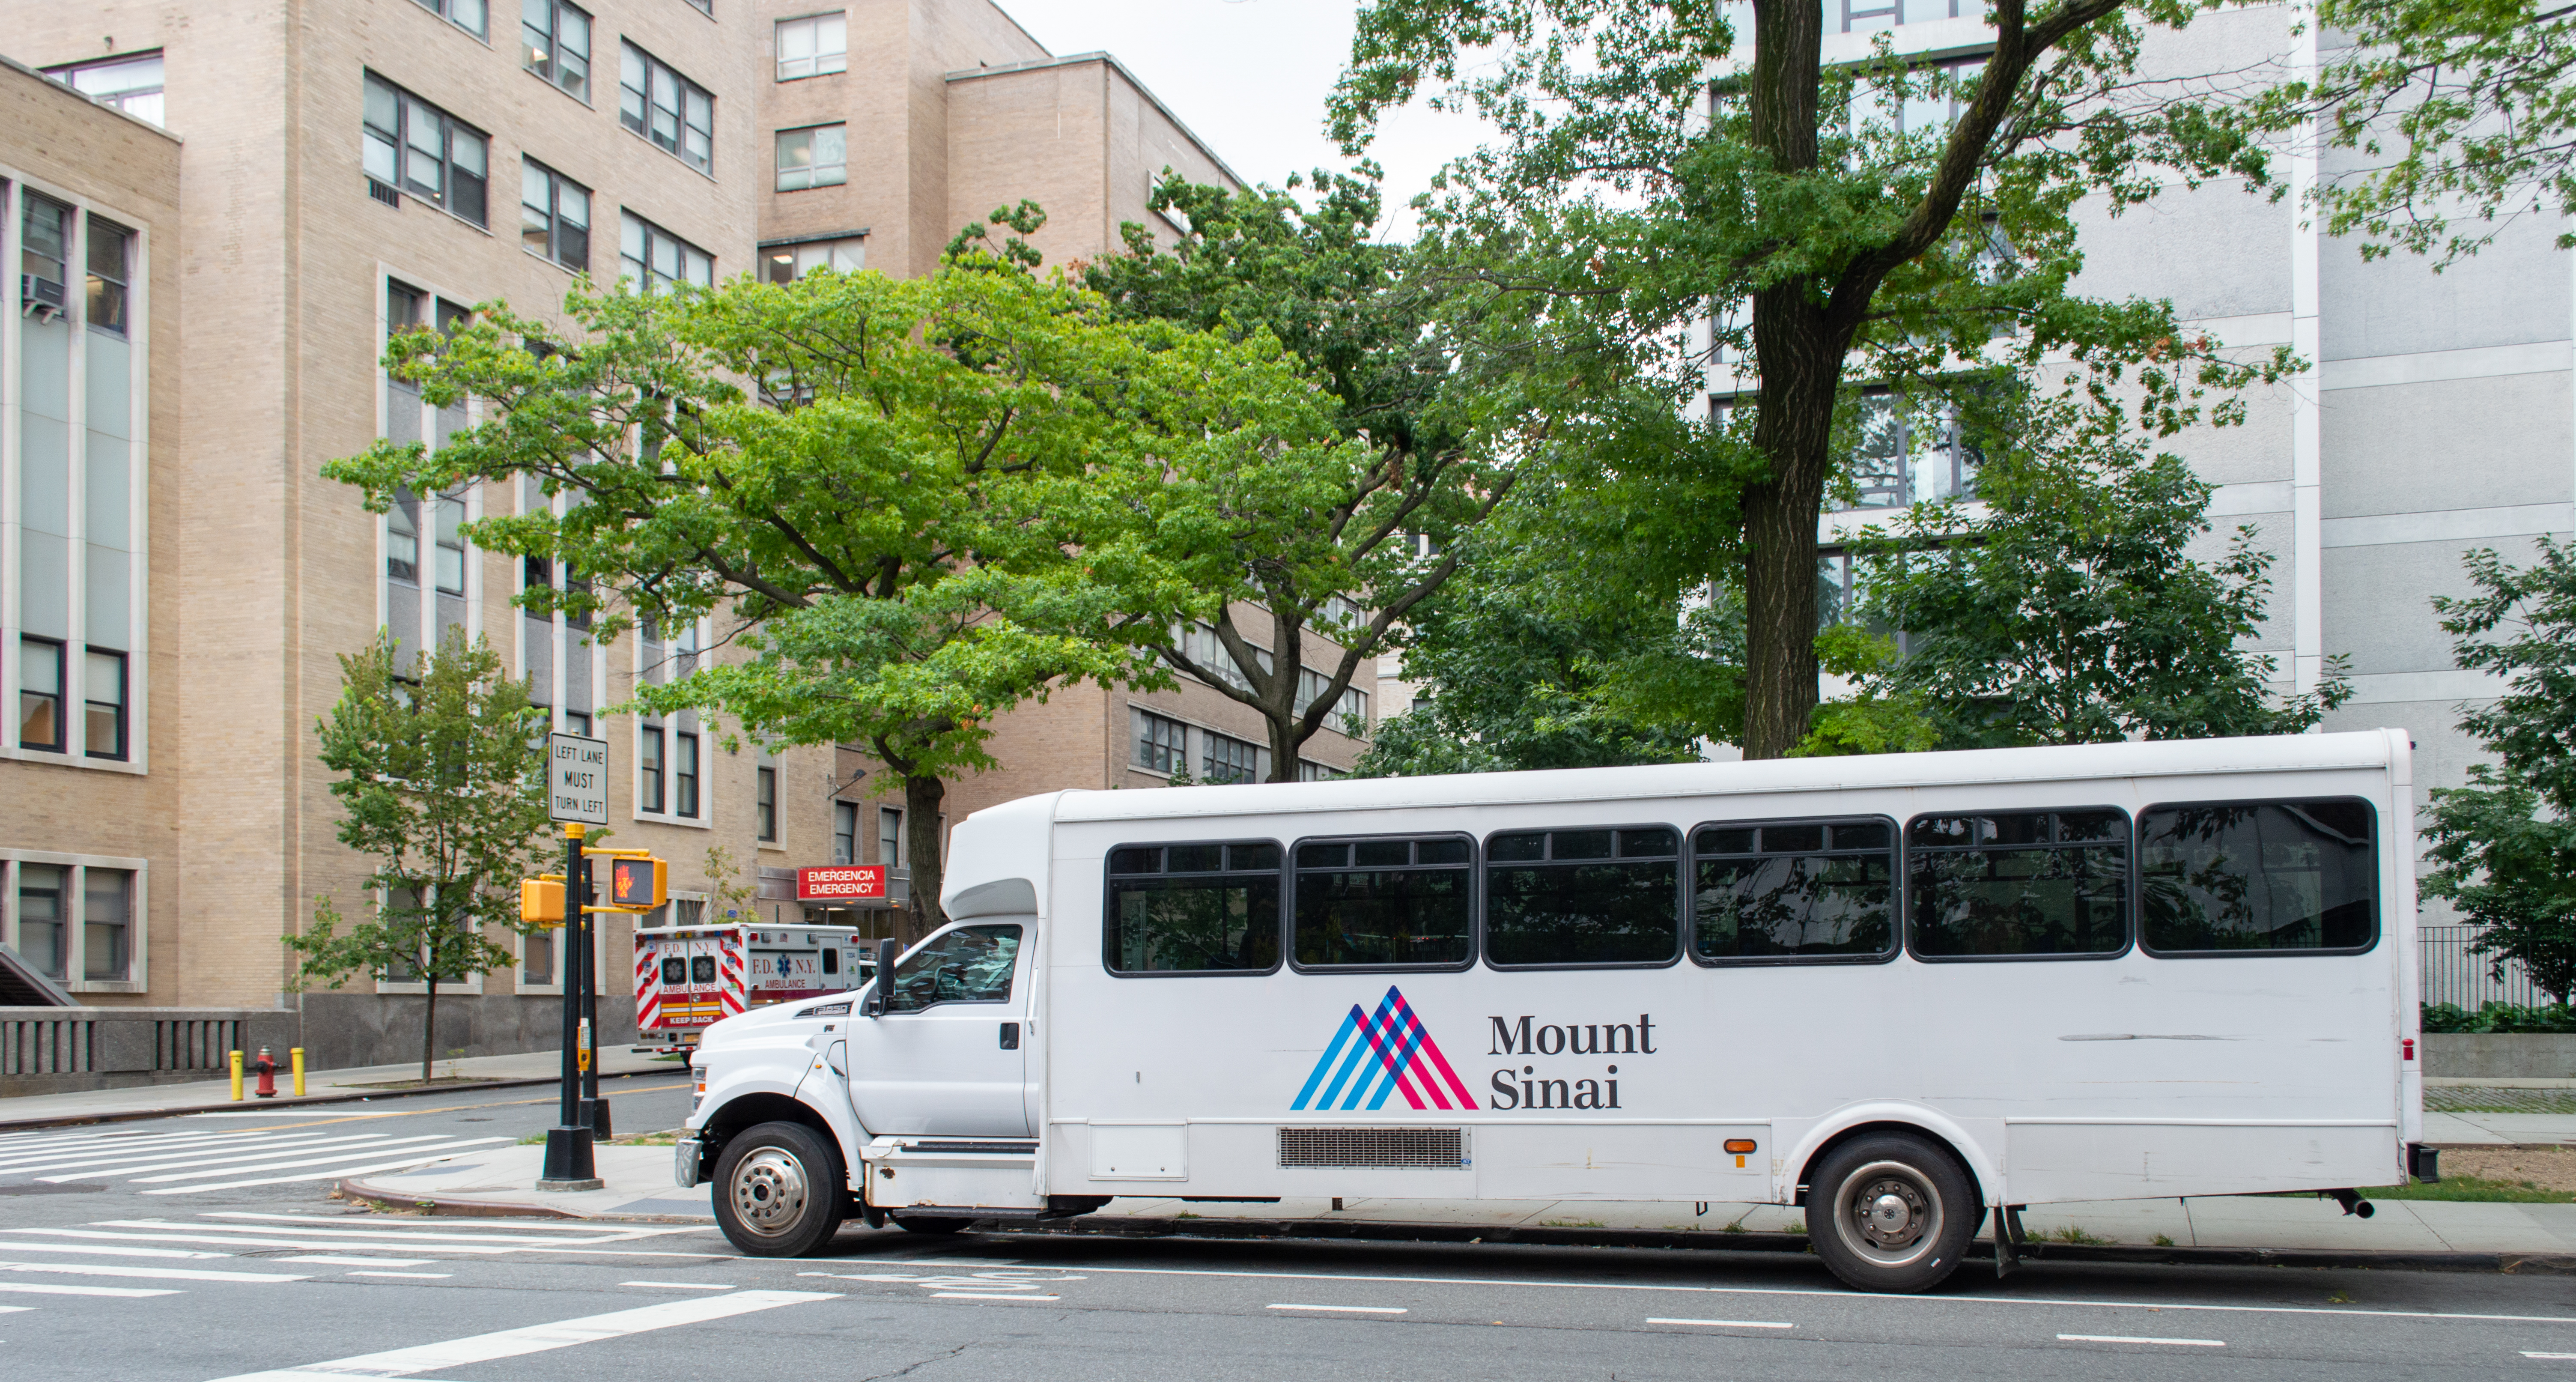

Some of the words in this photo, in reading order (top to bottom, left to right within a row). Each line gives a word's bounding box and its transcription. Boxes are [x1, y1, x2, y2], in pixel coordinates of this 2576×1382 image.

[556, 745, 577, 760] LEFT
[581, 749, 603, 764] LANE
[565, 771, 594, 789] MUST
[555, 796, 578, 810] TURN
[583, 800, 603, 813] LEFT
[808, 870, 875, 881] EMERGENCIA
[810, 883, 873, 894] EMERGENCY
[665, 944, 682, 953] F.D.
[695, 942, 713, 952] N.Y.
[753, 959, 773, 974] F.D.
[796, 959, 815, 974] N.Y.
[765, 979, 805, 989] AMBULANCE
[1488, 1013, 1657, 1055] Mount
[1491, 1065, 1622, 1110] Sinai
